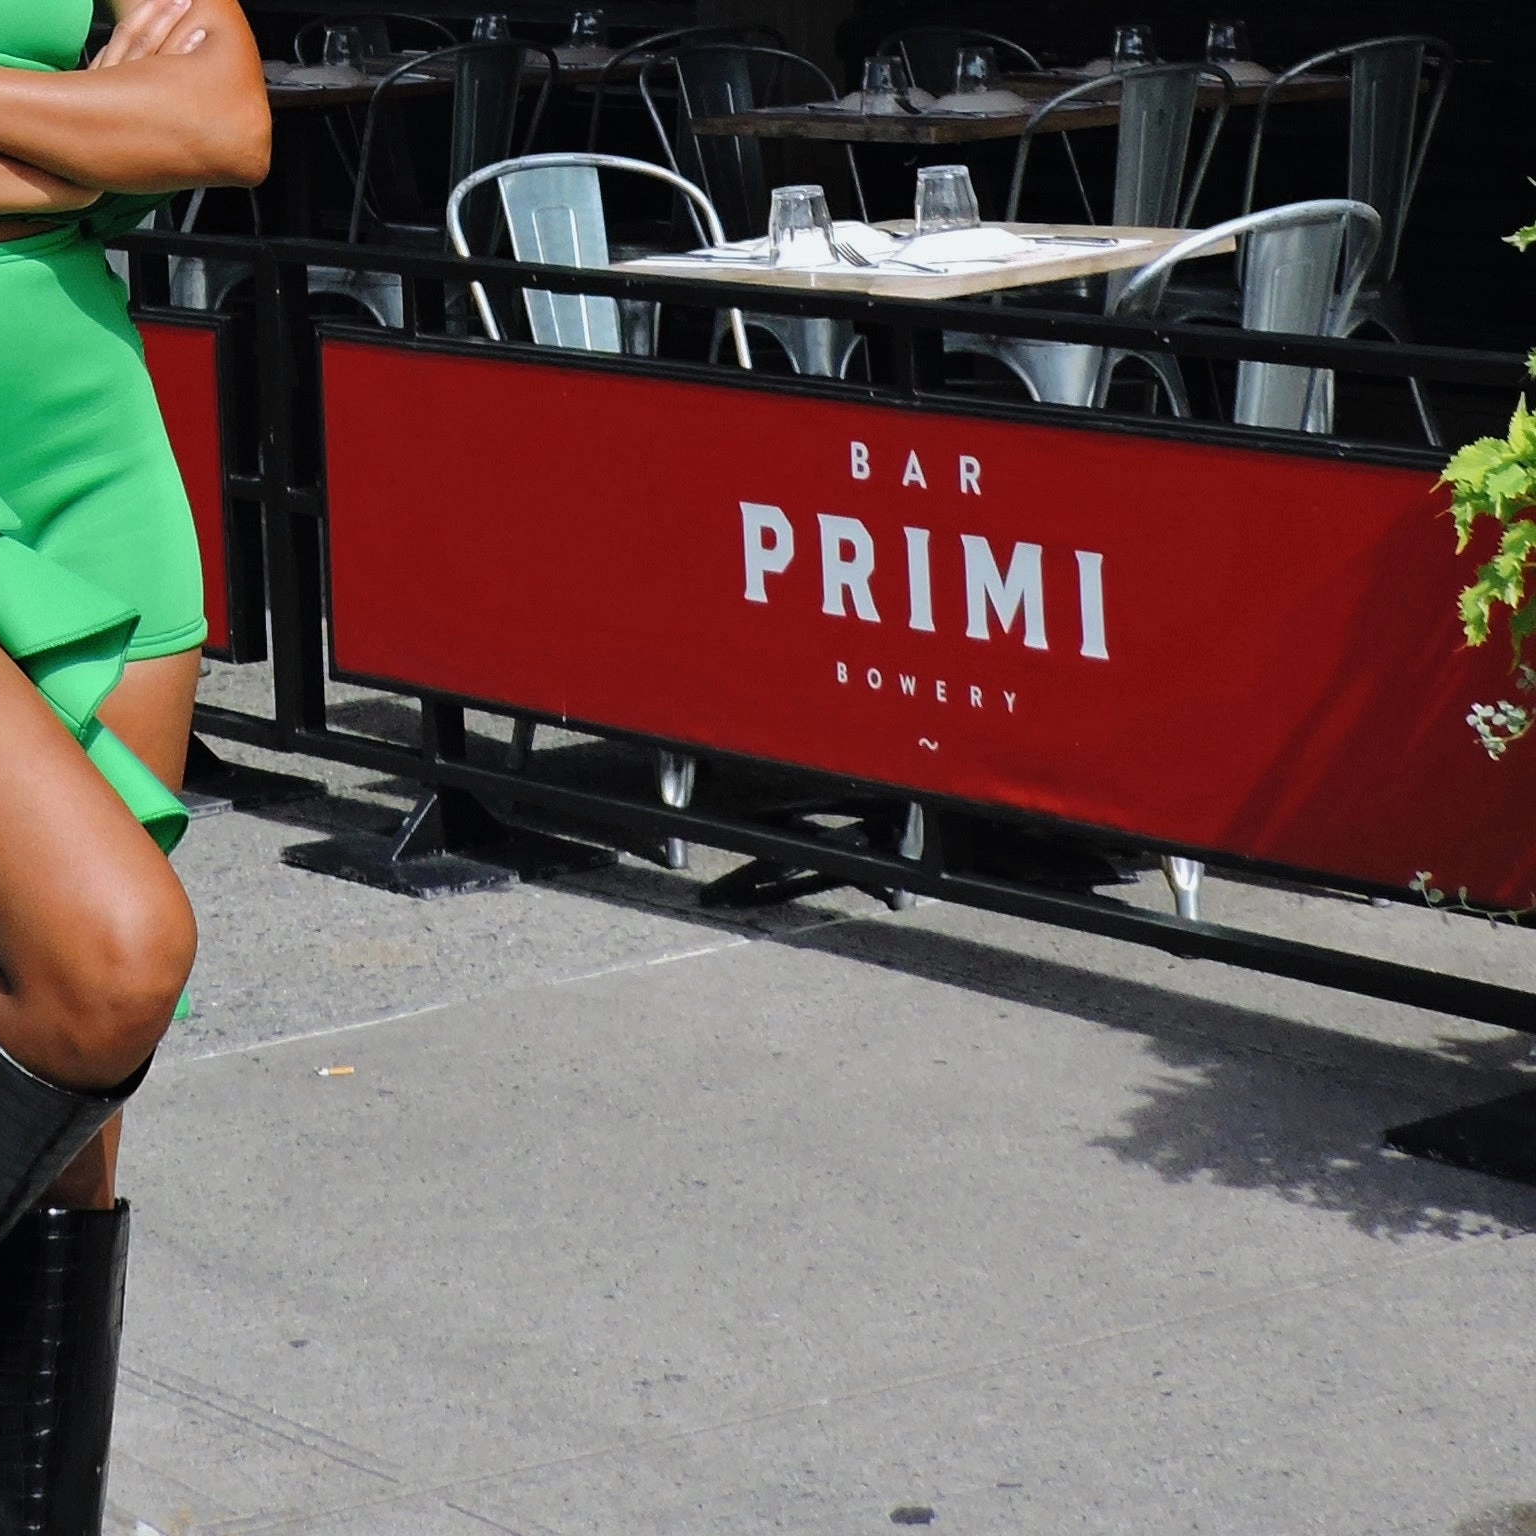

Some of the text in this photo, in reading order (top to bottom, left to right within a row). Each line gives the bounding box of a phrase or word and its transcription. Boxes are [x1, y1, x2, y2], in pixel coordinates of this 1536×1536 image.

[850, 441, 982, 496] BAR
[739, 501, 1110, 661] PRIMI
[836, 661, 1017, 714] BOWERY
